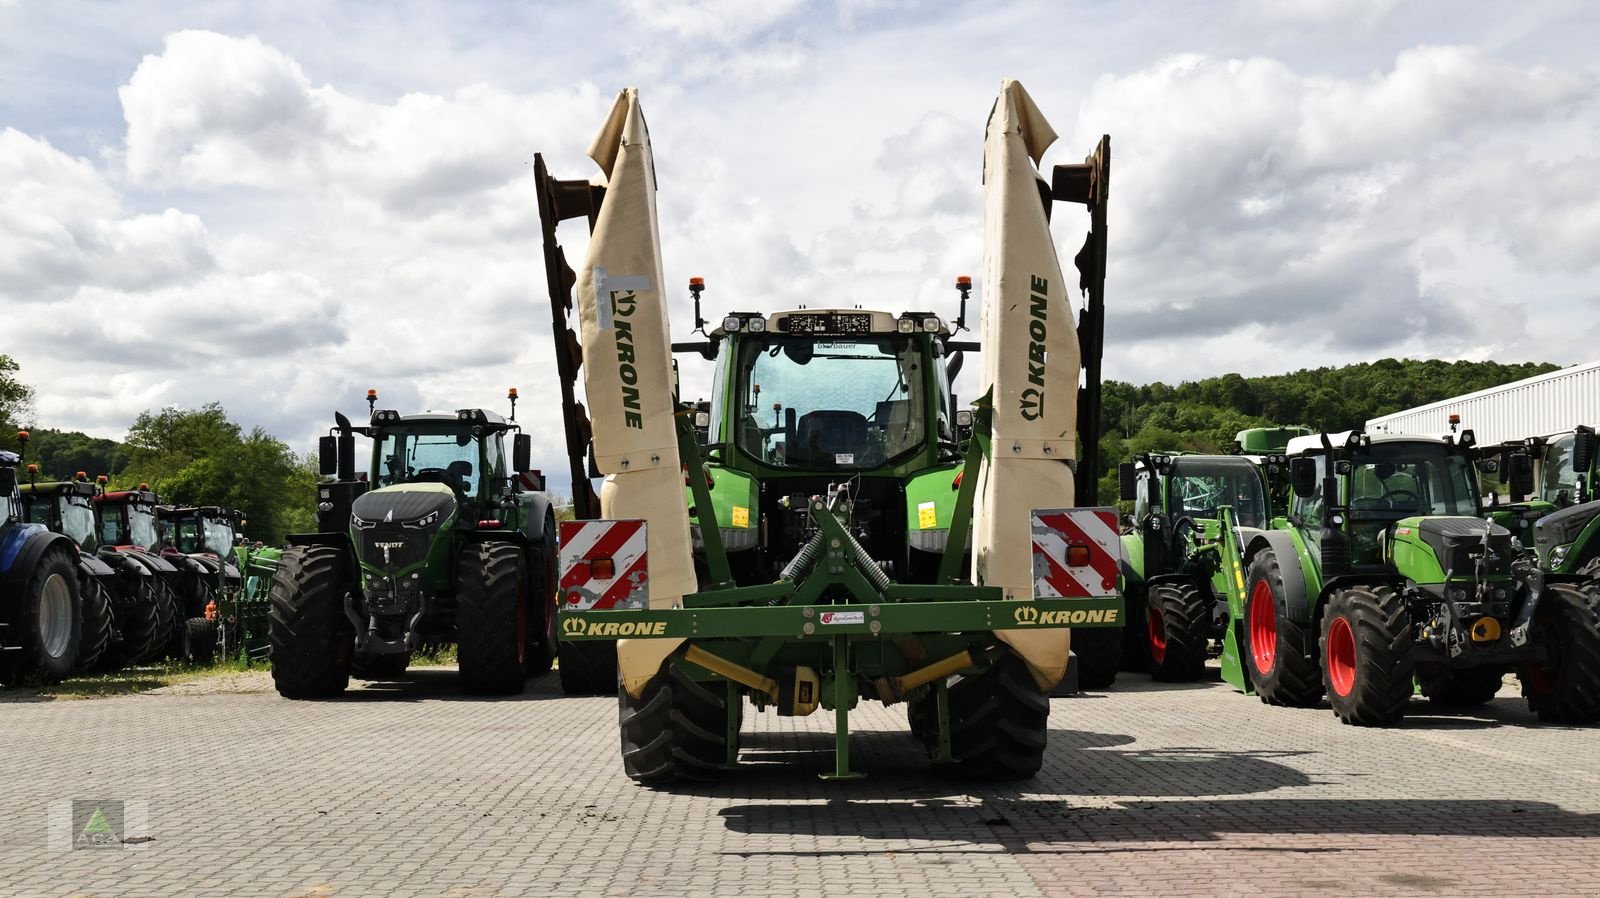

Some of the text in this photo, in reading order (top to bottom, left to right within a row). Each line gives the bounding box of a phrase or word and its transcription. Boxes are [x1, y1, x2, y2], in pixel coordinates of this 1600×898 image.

[1028, 274, 1048, 387] KRONE
[613, 319, 643, 430] KRONE
[587, 621, 668, 636] KRONE
[1039, 609, 1118, 625] KRONE
